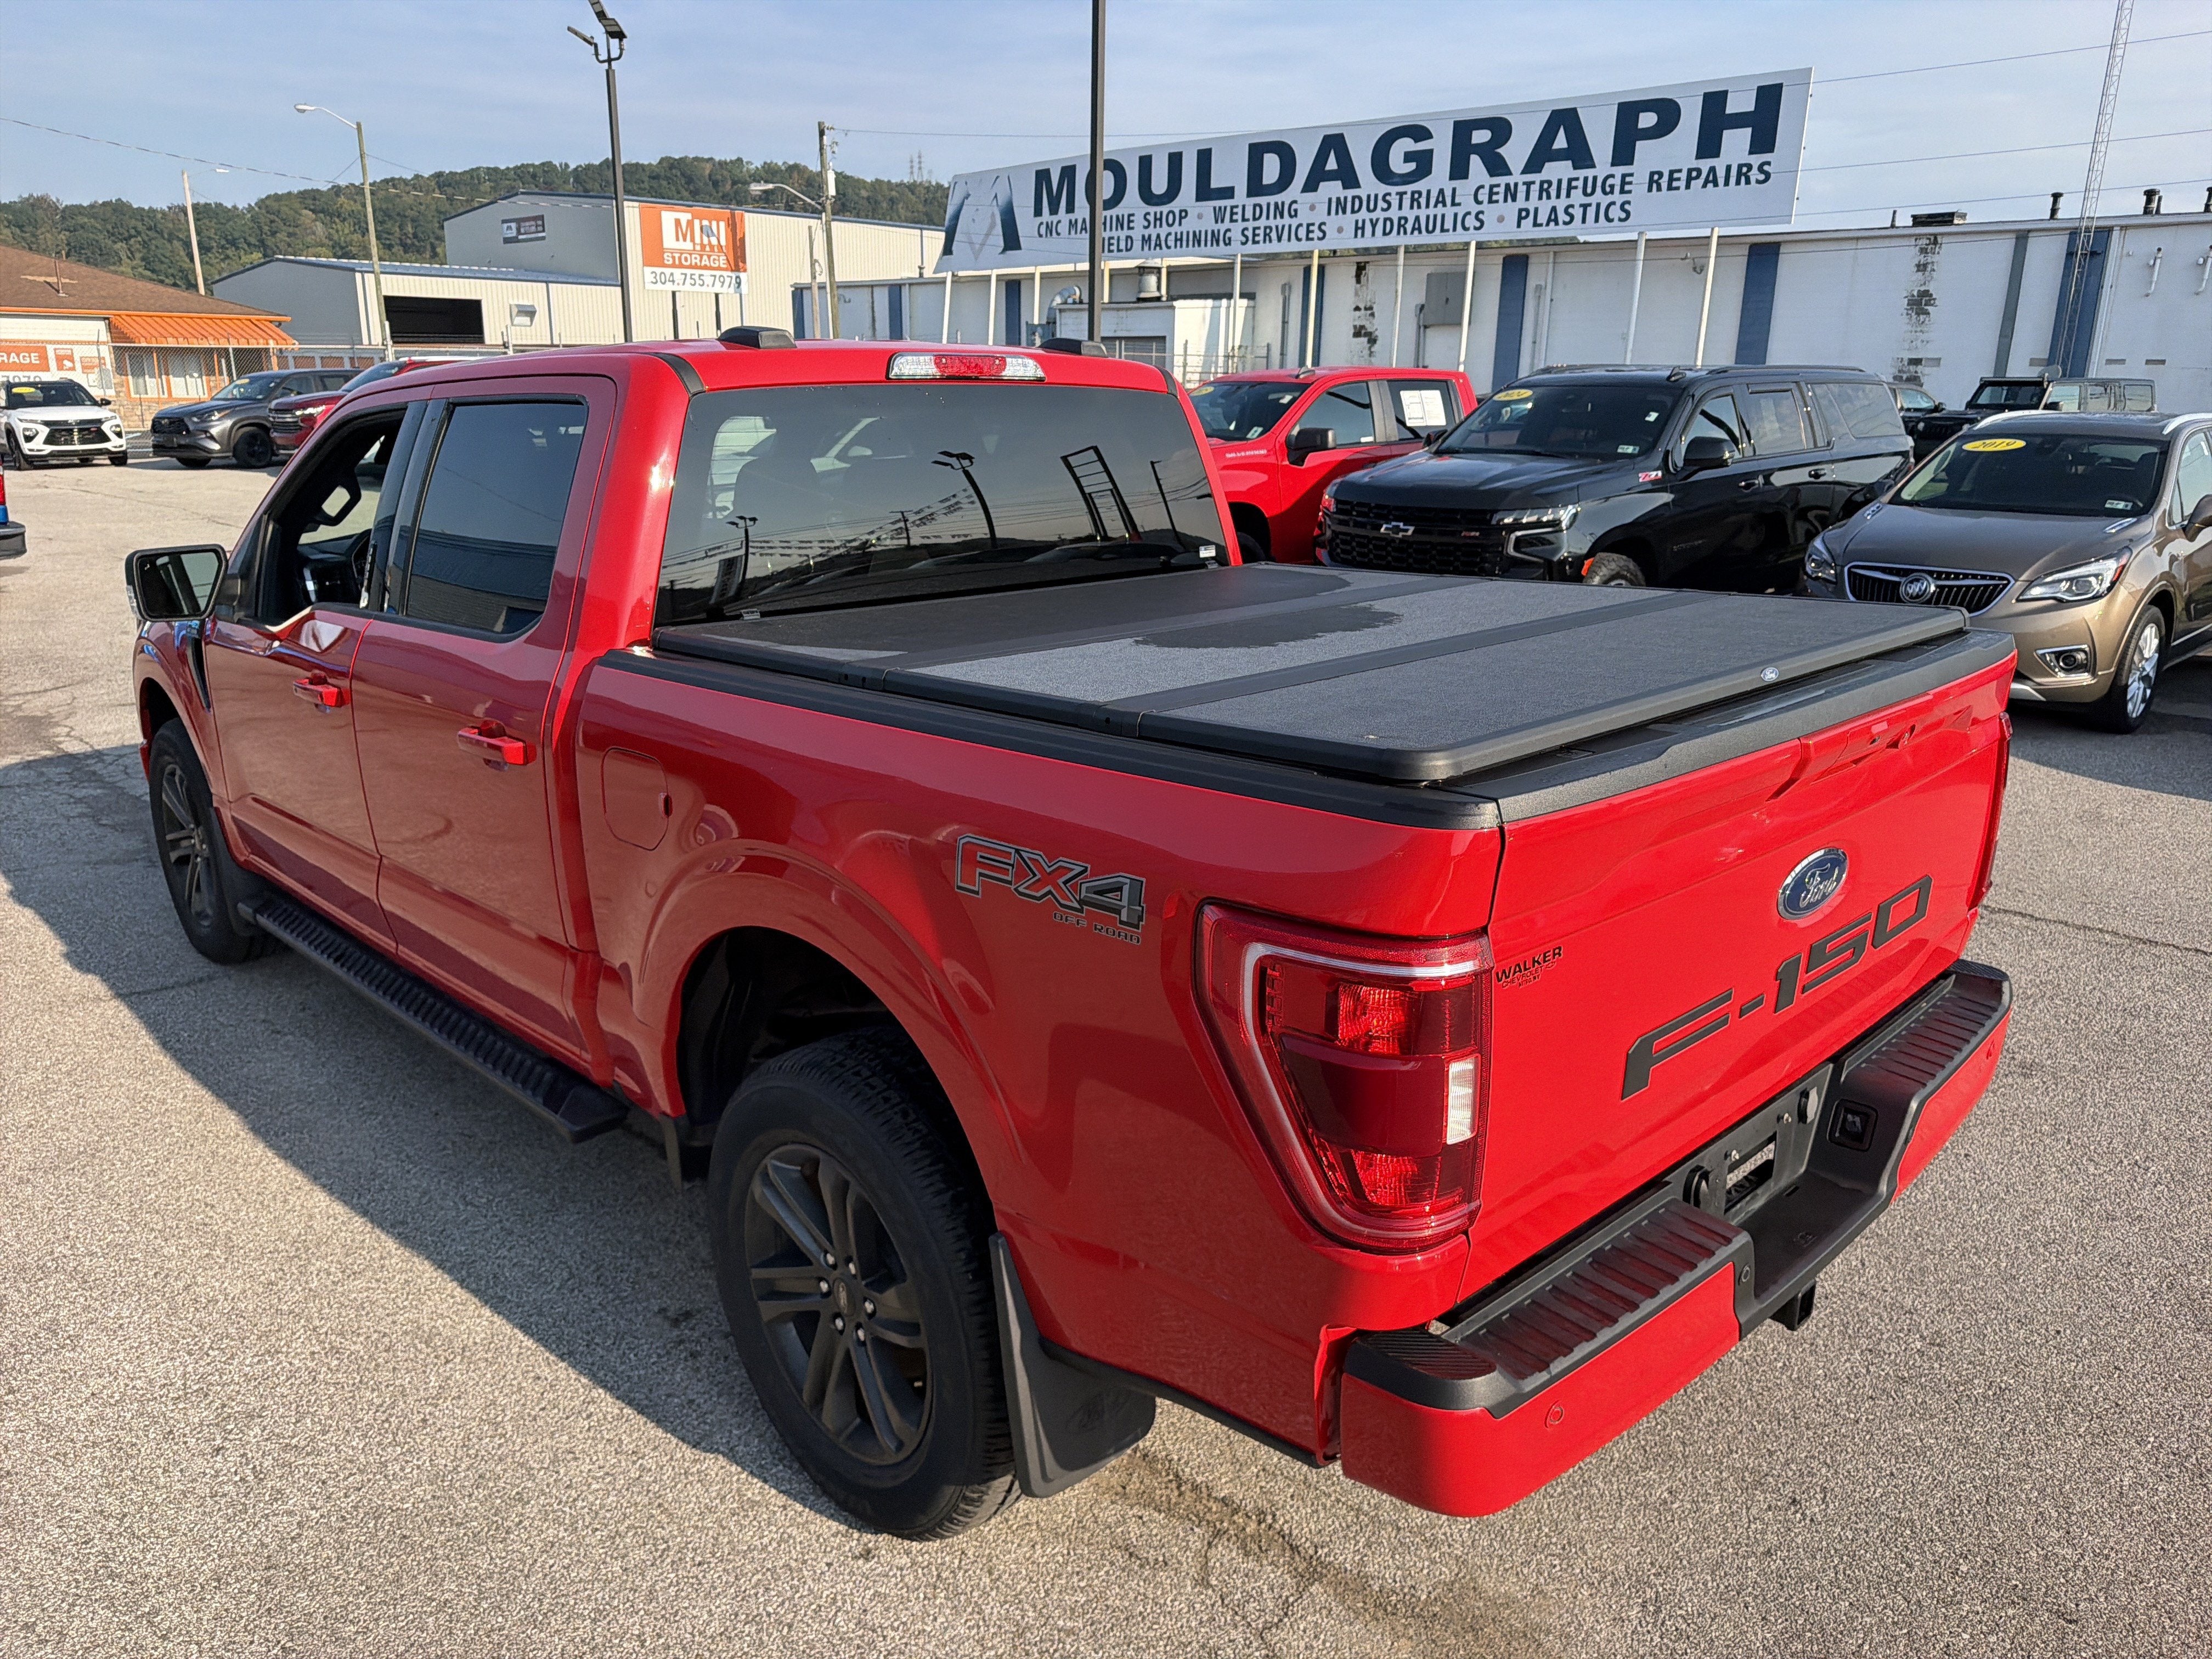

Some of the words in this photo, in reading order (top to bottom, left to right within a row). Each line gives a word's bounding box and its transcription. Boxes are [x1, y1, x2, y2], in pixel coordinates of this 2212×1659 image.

[1034, 83, 1784, 217] MOULDAGRAPH
[1037, 220, 1061, 238] CNC
[1068, 213, 1135, 235] MAHINE
[1143, 209, 1188, 229] SHOP
[1213, 200, 1298, 224] WELDING
[1327, 188, 1462, 216] INDUSTRIAL
[1473, 172, 1634, 205] CENTRIFUGE
[1647, 161, 1771, 193] REPAIRS
[674, 218, 727, 246] MINI
[1102, 235, 1133, 253] IELD
[1141, 228, 1232, 251] MACHINING
[1240, 222, 1327, 246] SERVICES
[1354, 210, 1485, 239] HYDRAULICS
[1516, 200, 1631, 228] PLASTICS
[650, 270, 742, 289] 304.755.7979
[663, 252, 727, 268] STORAGE
[1970, 441, 2017, 449] 2019
[955, 833, 1146, 933] FX4
[1799, 862, 1839, 909] Ford
[1053, 911, 1087, 927] OFF
[1093, 922, 1141, 945] ROAD
[1496, 946, 1562, 983] WALKER
[1621, 875, 1932, 1101] F-150
